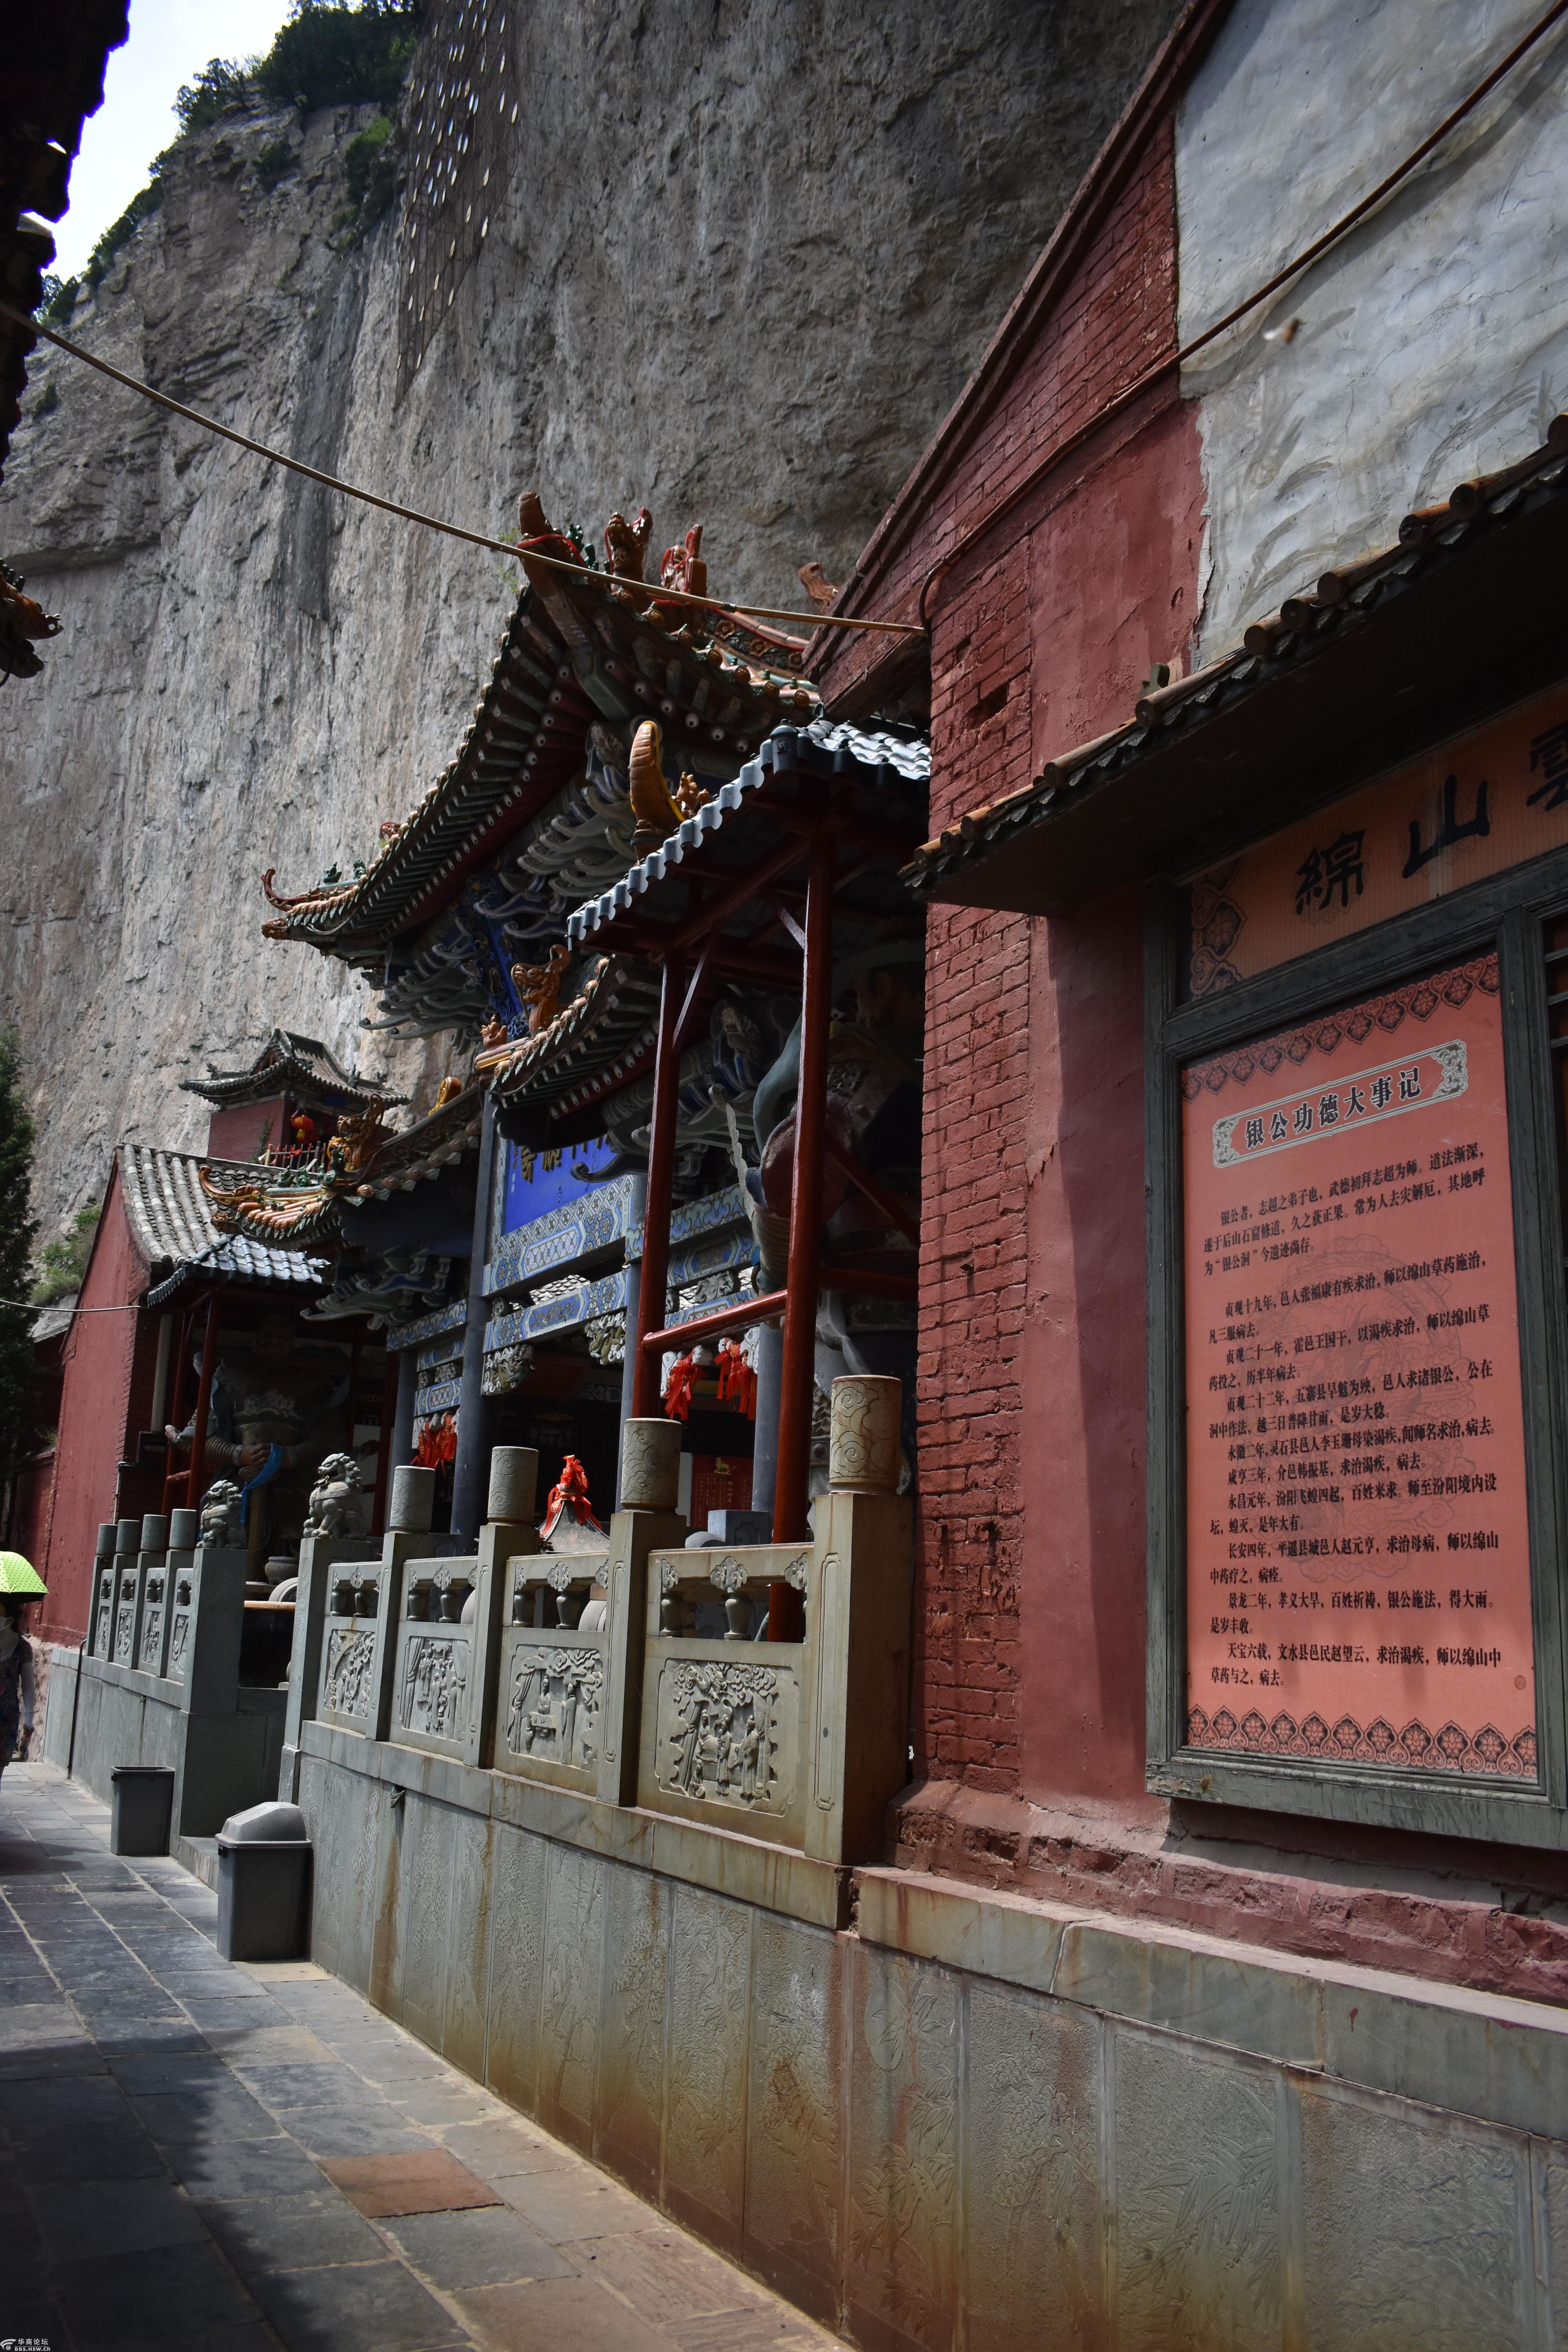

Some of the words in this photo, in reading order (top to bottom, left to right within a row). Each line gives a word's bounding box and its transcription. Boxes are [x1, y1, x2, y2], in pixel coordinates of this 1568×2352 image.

[1245, 1067, 1421, 1149] 银公功德大事记
[1209, 1321, 1260, 1344] 凡三服病去。
[1208, 1363, 1301, 1391] 药投之，历半年病去。
[1209, 1514, 1305, 1535] 坛，蝗灭，是年大有。
[1209, 1566, 1284, 1585] 中药疗之，病痊。
[1209, 1617, 1254, 1635] 是岁丰收。
[1210, 1666, 1285, 1687] 草药与之，病去。
